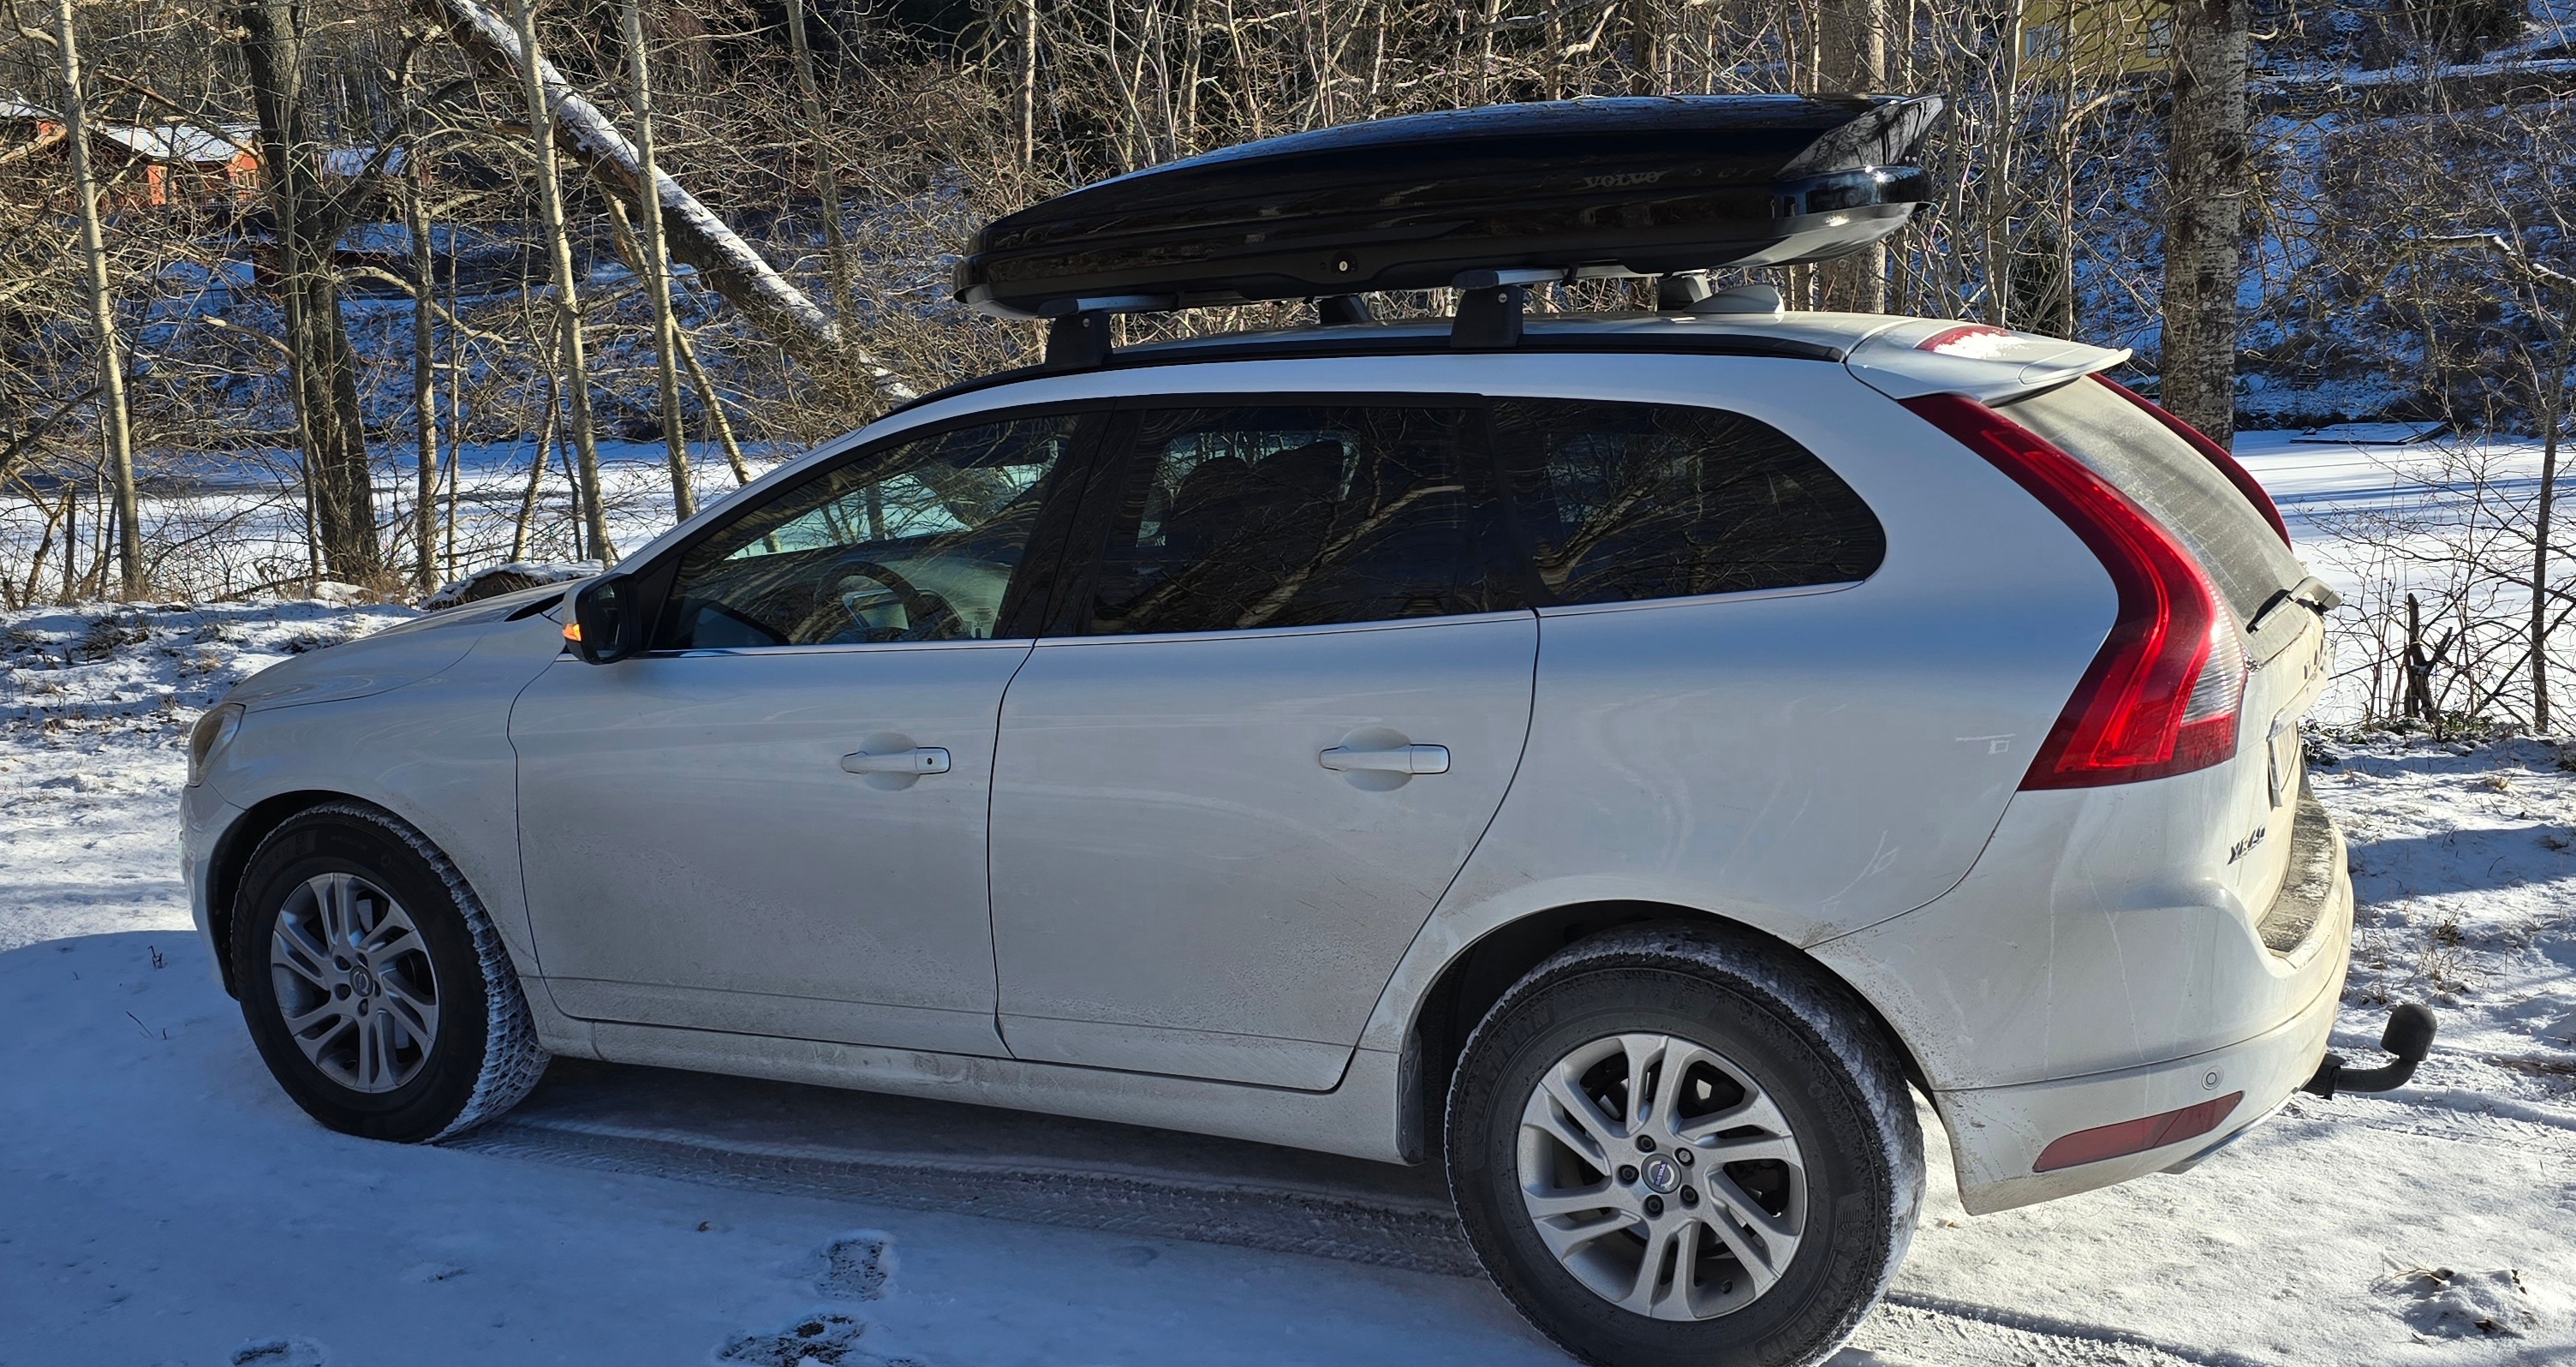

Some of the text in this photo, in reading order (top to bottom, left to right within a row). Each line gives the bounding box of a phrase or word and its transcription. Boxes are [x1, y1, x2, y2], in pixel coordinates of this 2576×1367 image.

[1582, 170, 1660, 188] VOLVO
[1470, 998, 1553, 1116] MICHELIN
[1761, 1253, 1852, 1363] MICHELIN
